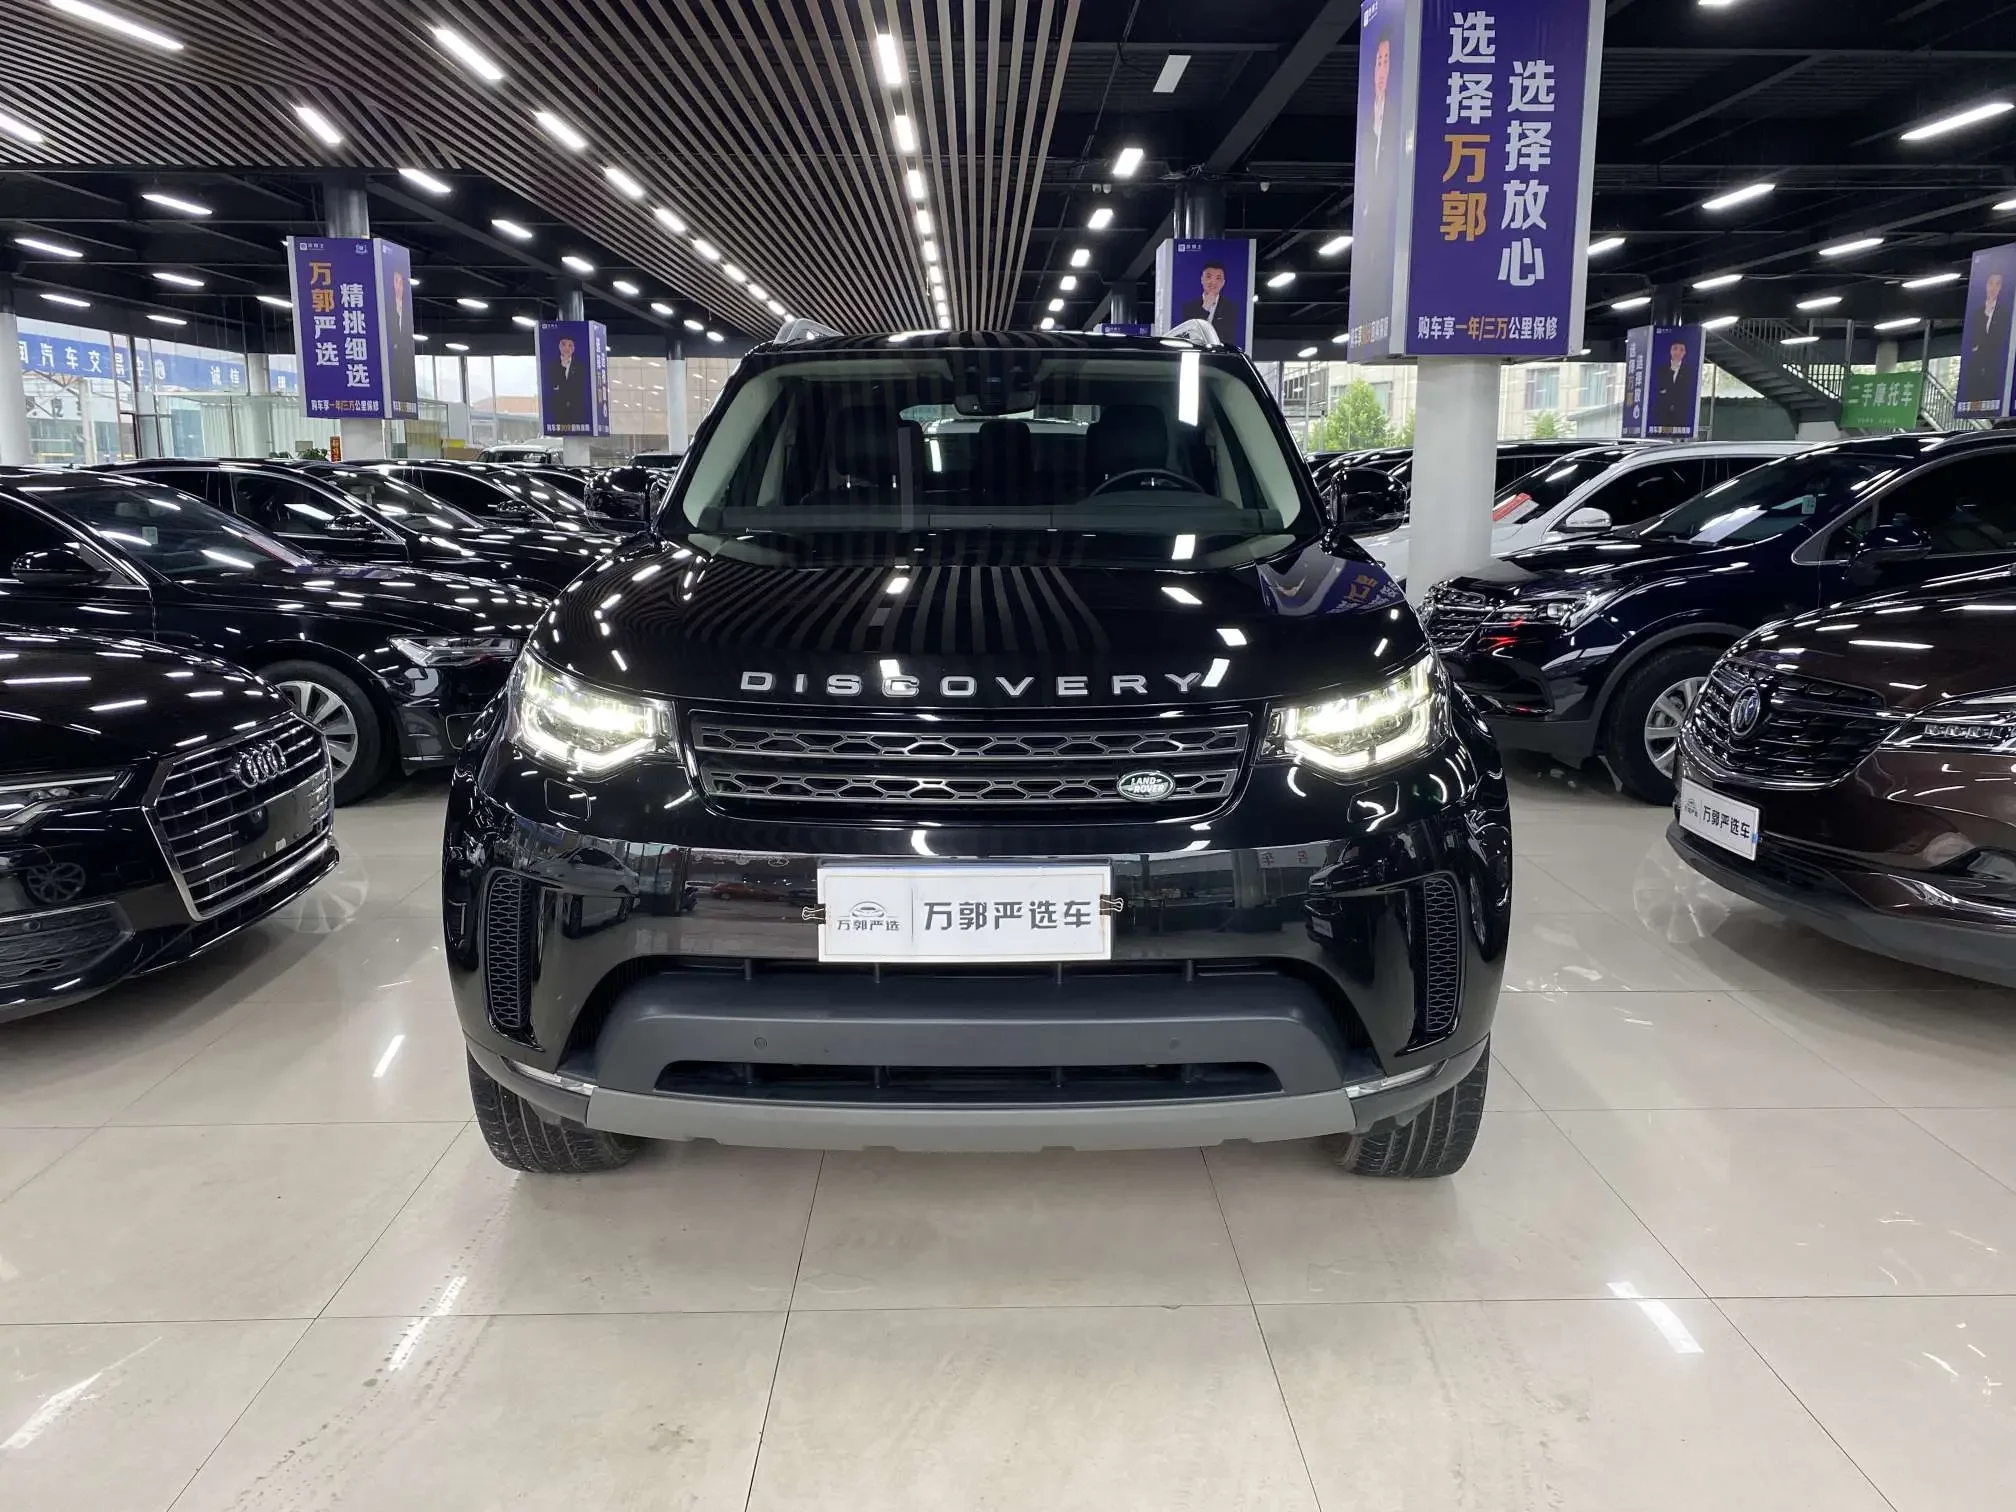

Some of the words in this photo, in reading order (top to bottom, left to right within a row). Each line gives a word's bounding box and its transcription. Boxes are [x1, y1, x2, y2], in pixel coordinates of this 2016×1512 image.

[1440, 11, 1496, 241] 选择万郭
[1498, 60, 1555, 286] 选择放心
[309, 262, 339, 366] 万郭严选
[340, 283, 370, 387] 精挑细选
[741, 671, 1200, 697] DISCOVERY
[837, 919, 900, 932] 万郭严选
[923, 900, 1091, 930] 万郭严选车
